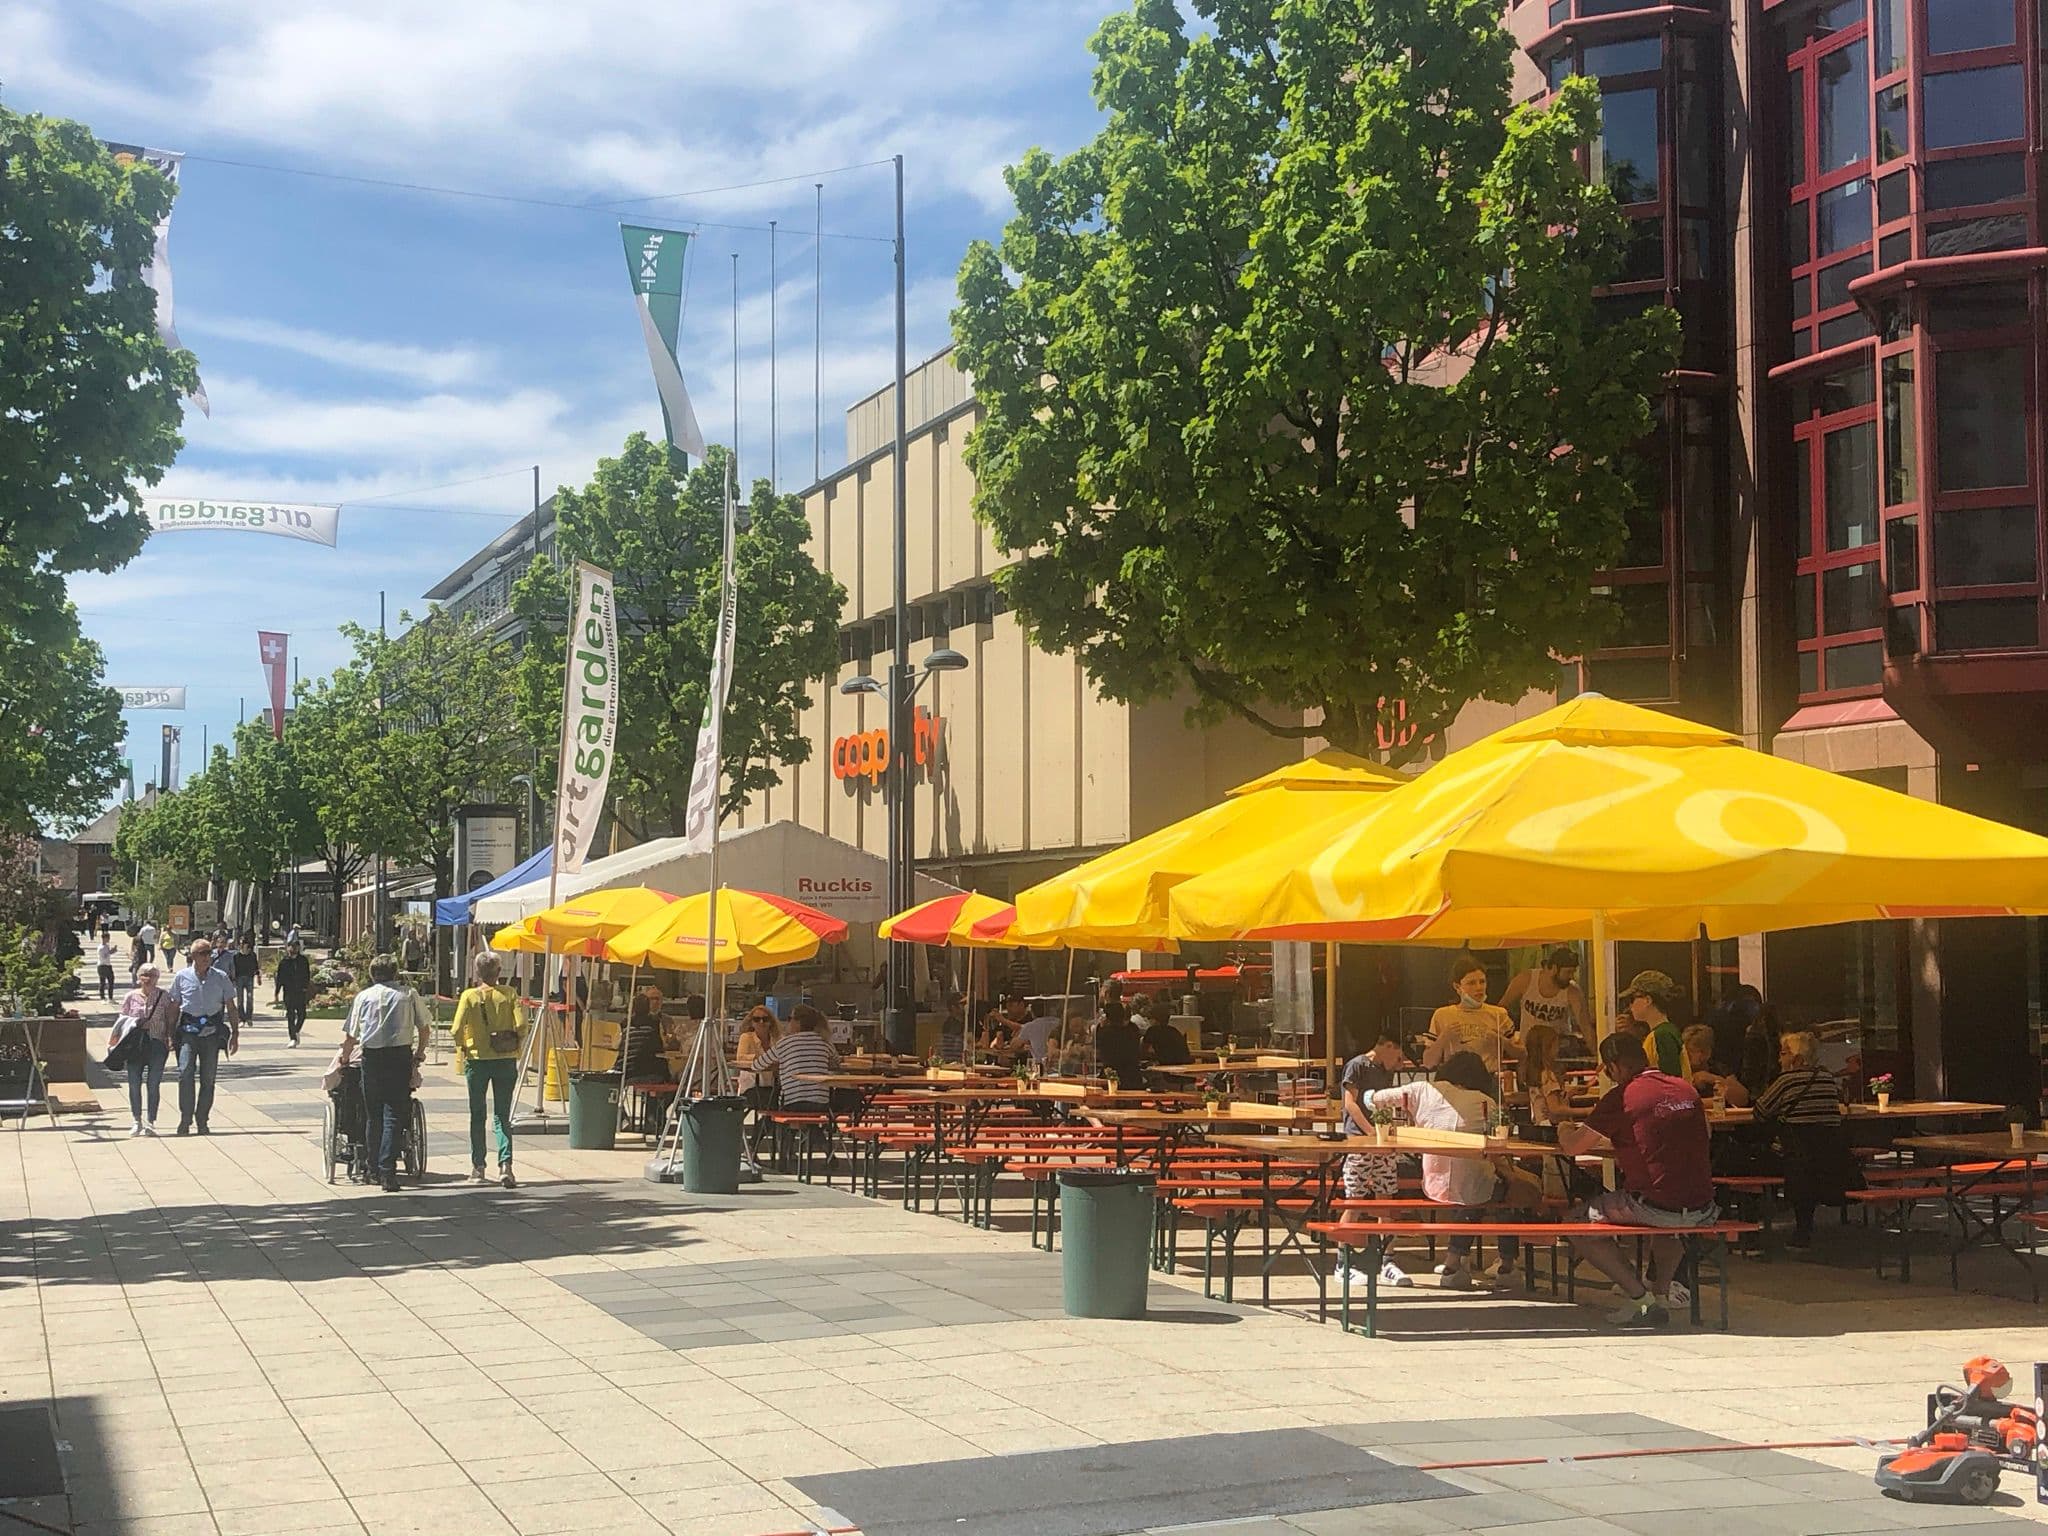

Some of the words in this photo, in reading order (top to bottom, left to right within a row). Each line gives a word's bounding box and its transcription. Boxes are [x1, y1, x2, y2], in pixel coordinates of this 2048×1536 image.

[605, 727, 613, 747] die
[833, 729, 890, 787] coop
[798, 877, 873, 893] Ruckis
